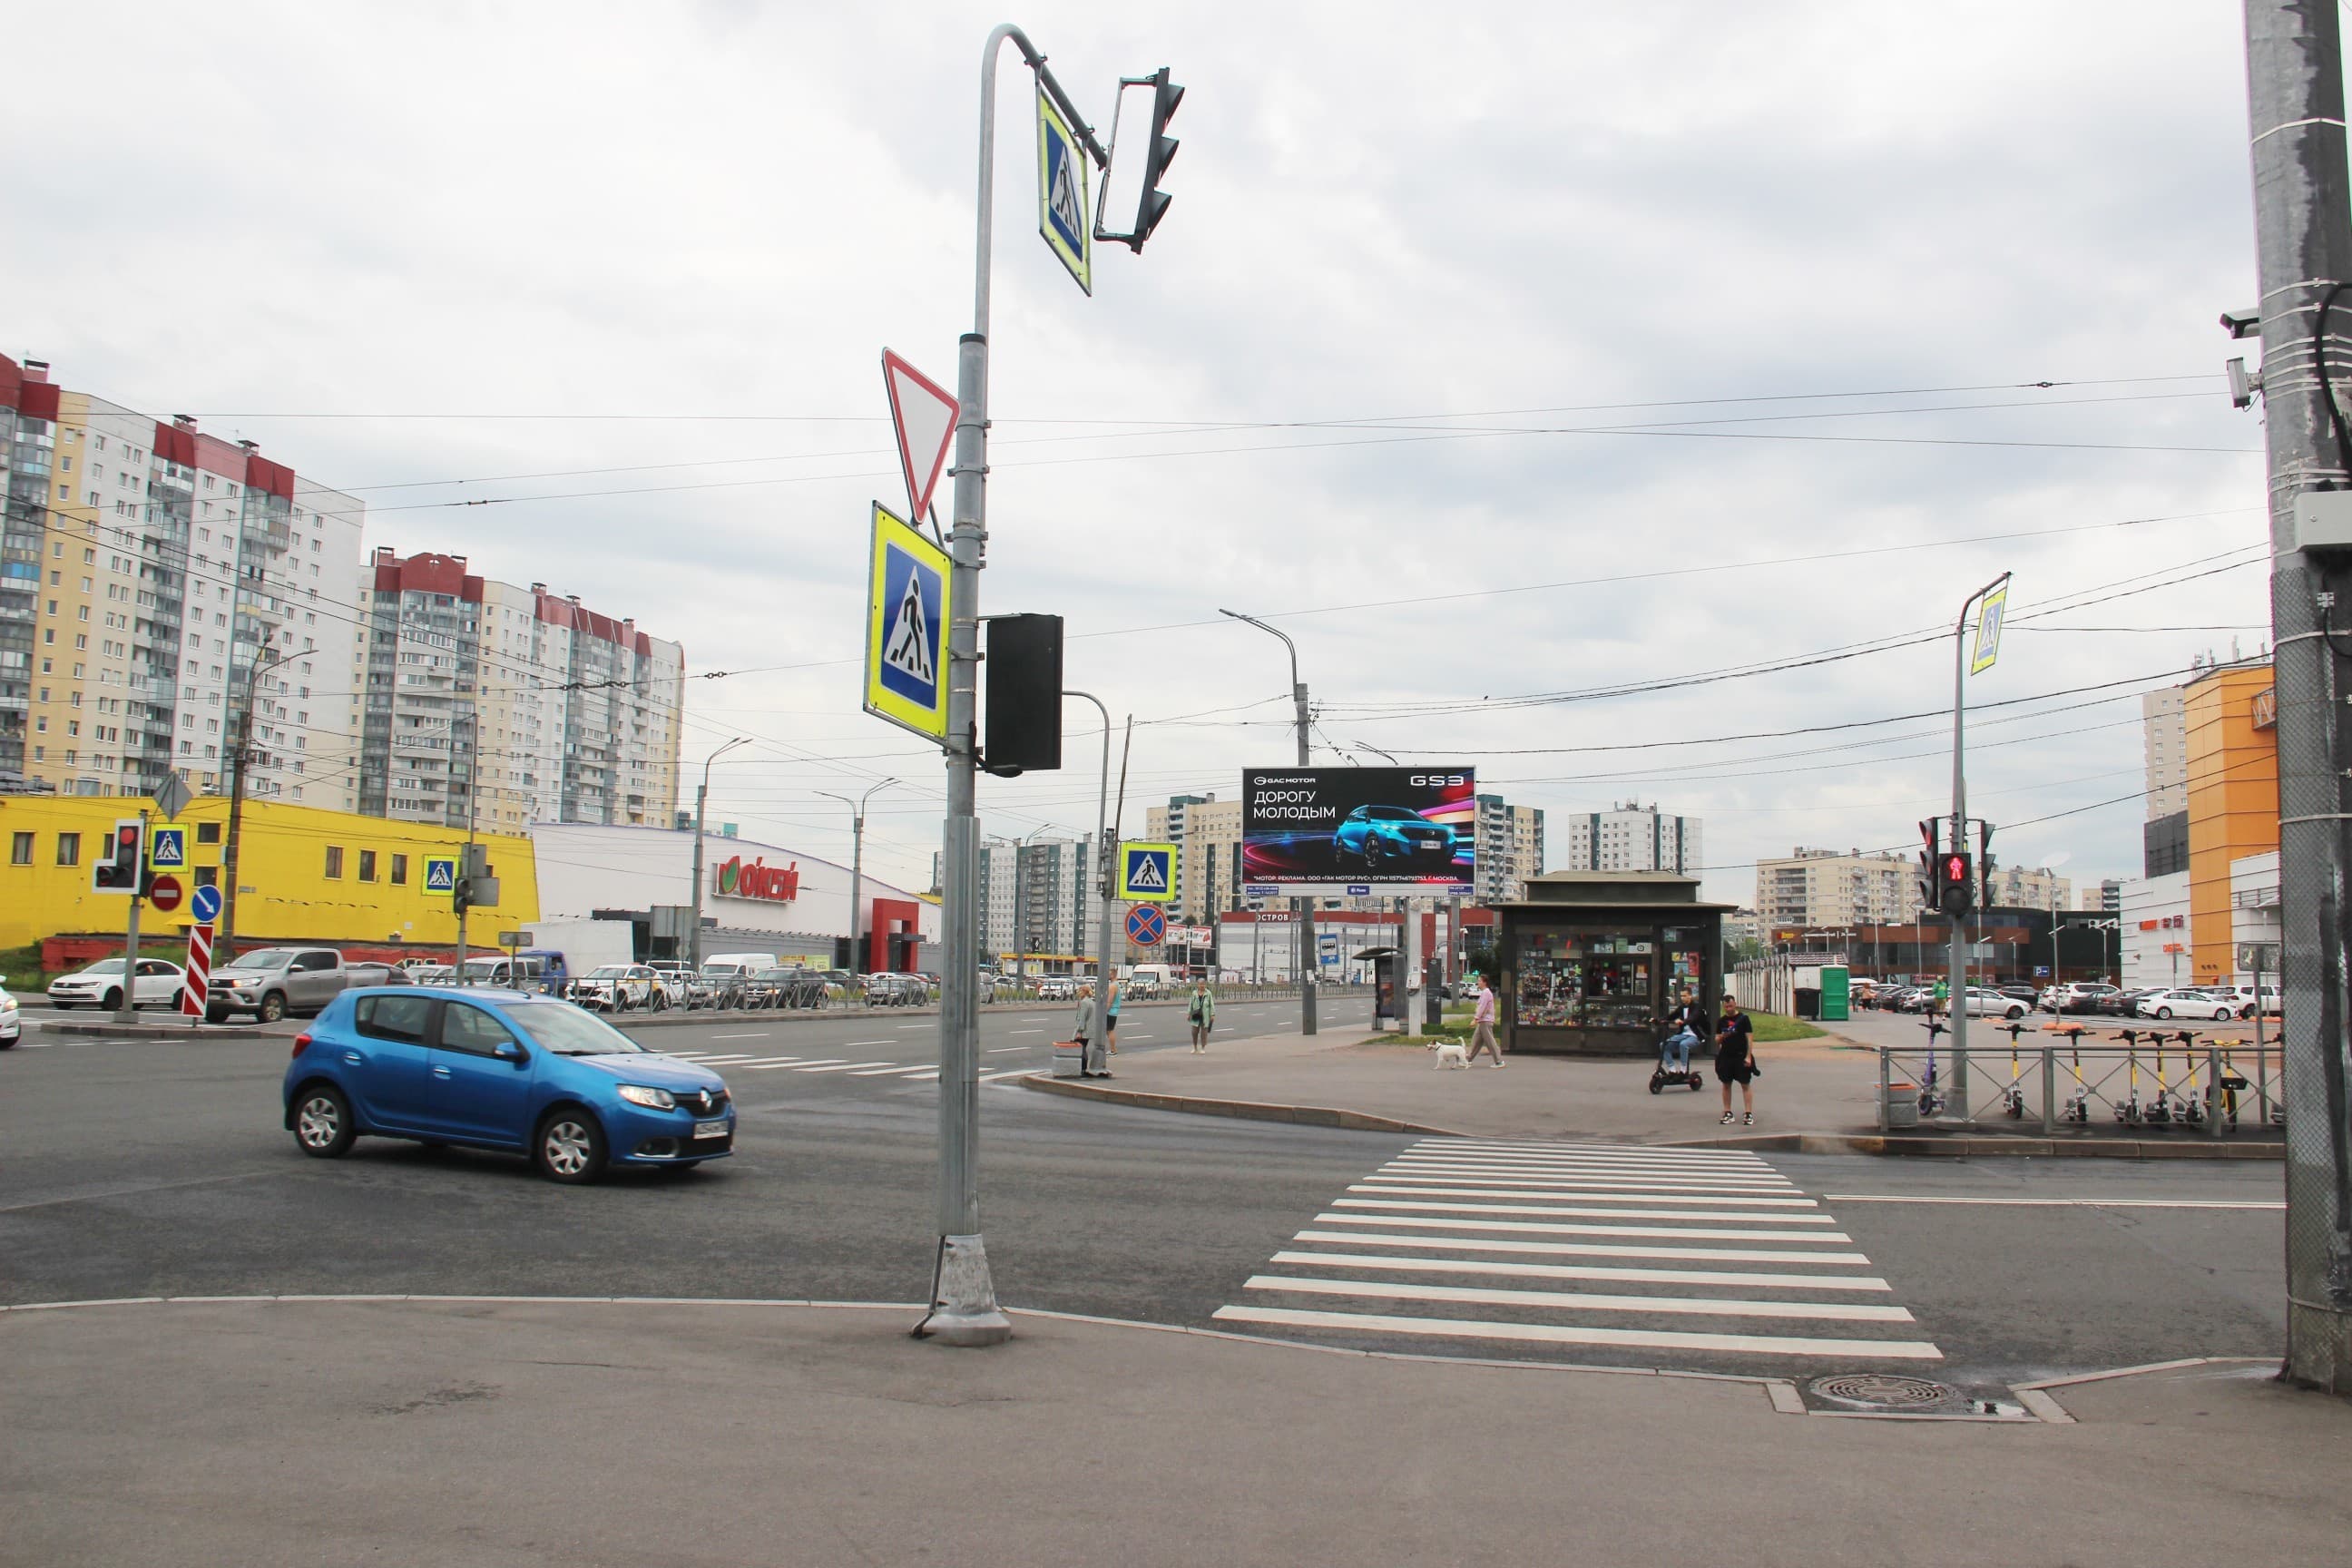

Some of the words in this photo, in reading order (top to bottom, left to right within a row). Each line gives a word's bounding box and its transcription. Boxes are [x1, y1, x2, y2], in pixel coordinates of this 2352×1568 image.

[1410, 775, 1465, 787] GS3
[1254, 790, 1317, 805] ДОРОГУ
[1253, 806, 1336, 821] МОЛОДЫМ
